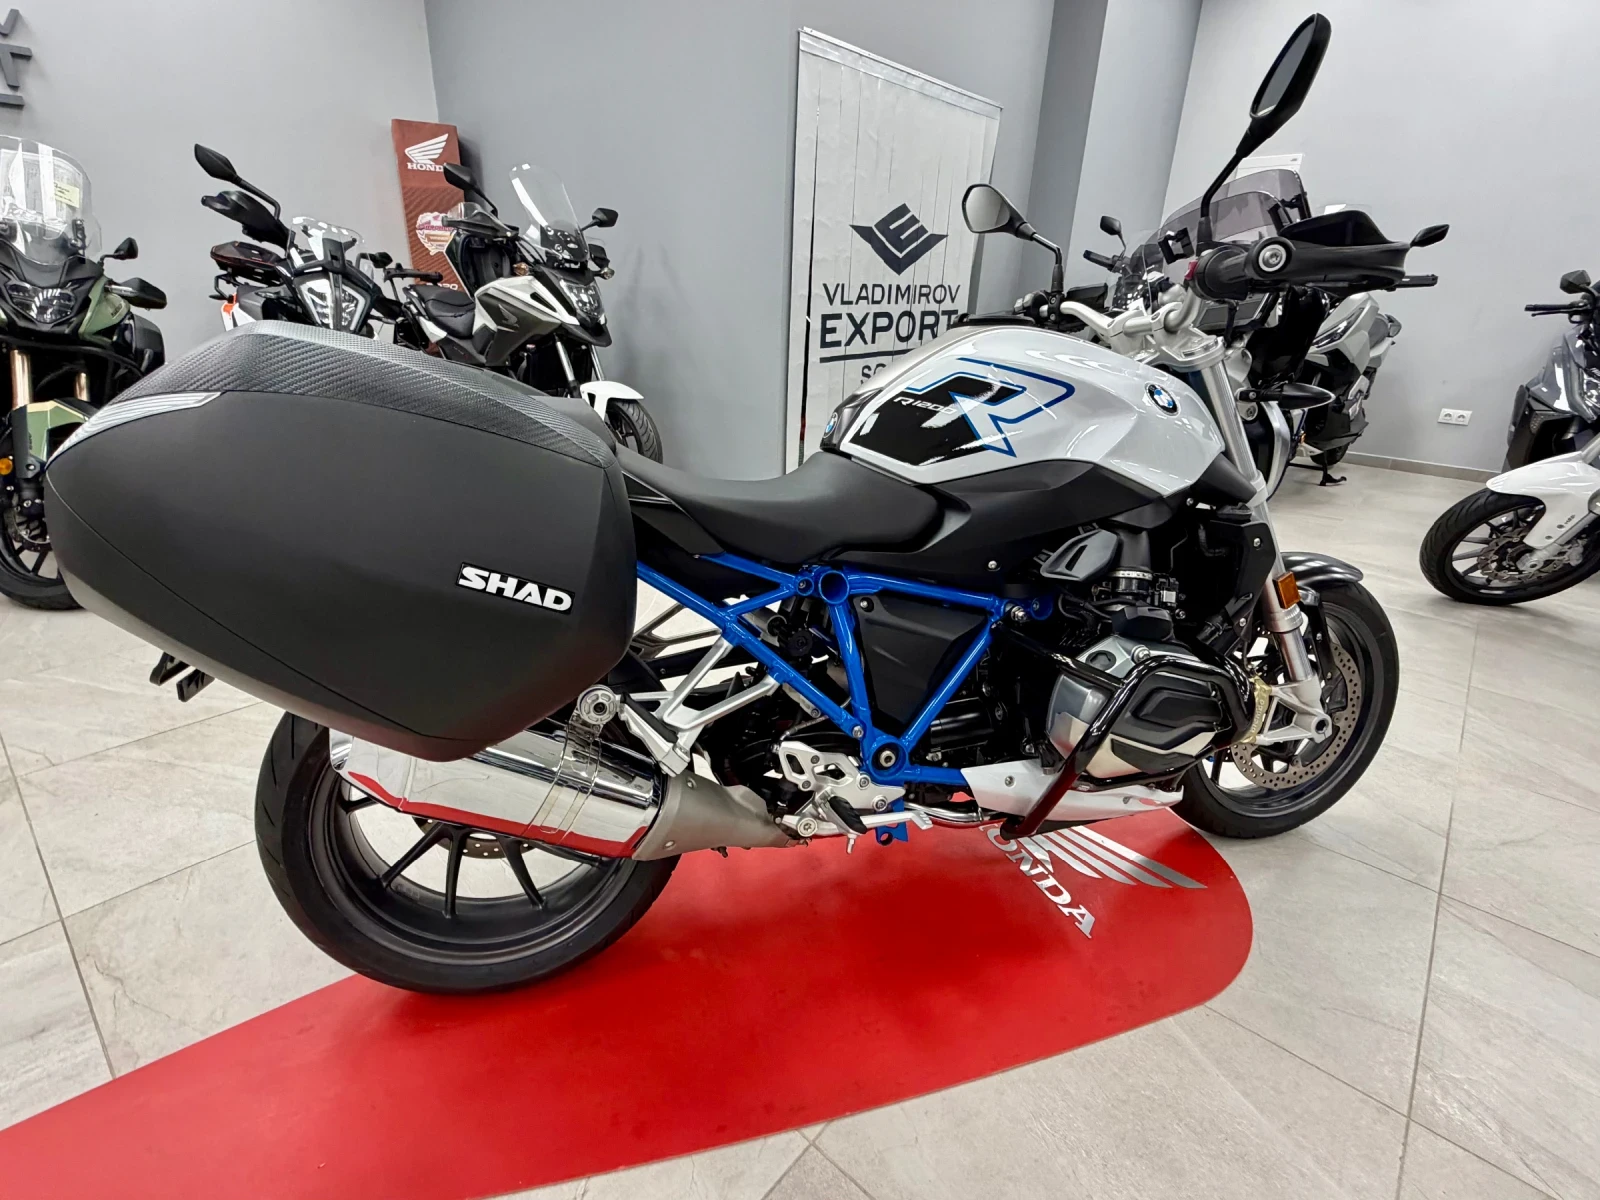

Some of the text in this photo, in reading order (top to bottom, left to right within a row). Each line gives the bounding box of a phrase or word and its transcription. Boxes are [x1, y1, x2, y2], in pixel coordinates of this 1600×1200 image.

[407, 162, 445, 172] HOND
[822, 283, 961, 306] VLADIMIROV
[820, 309, 959, 349] EXPORT
[893, 396, 957, 414] R1200
[458, 566, 572, 611] SHAD
[979, 823, 1096, 938] ONDA
